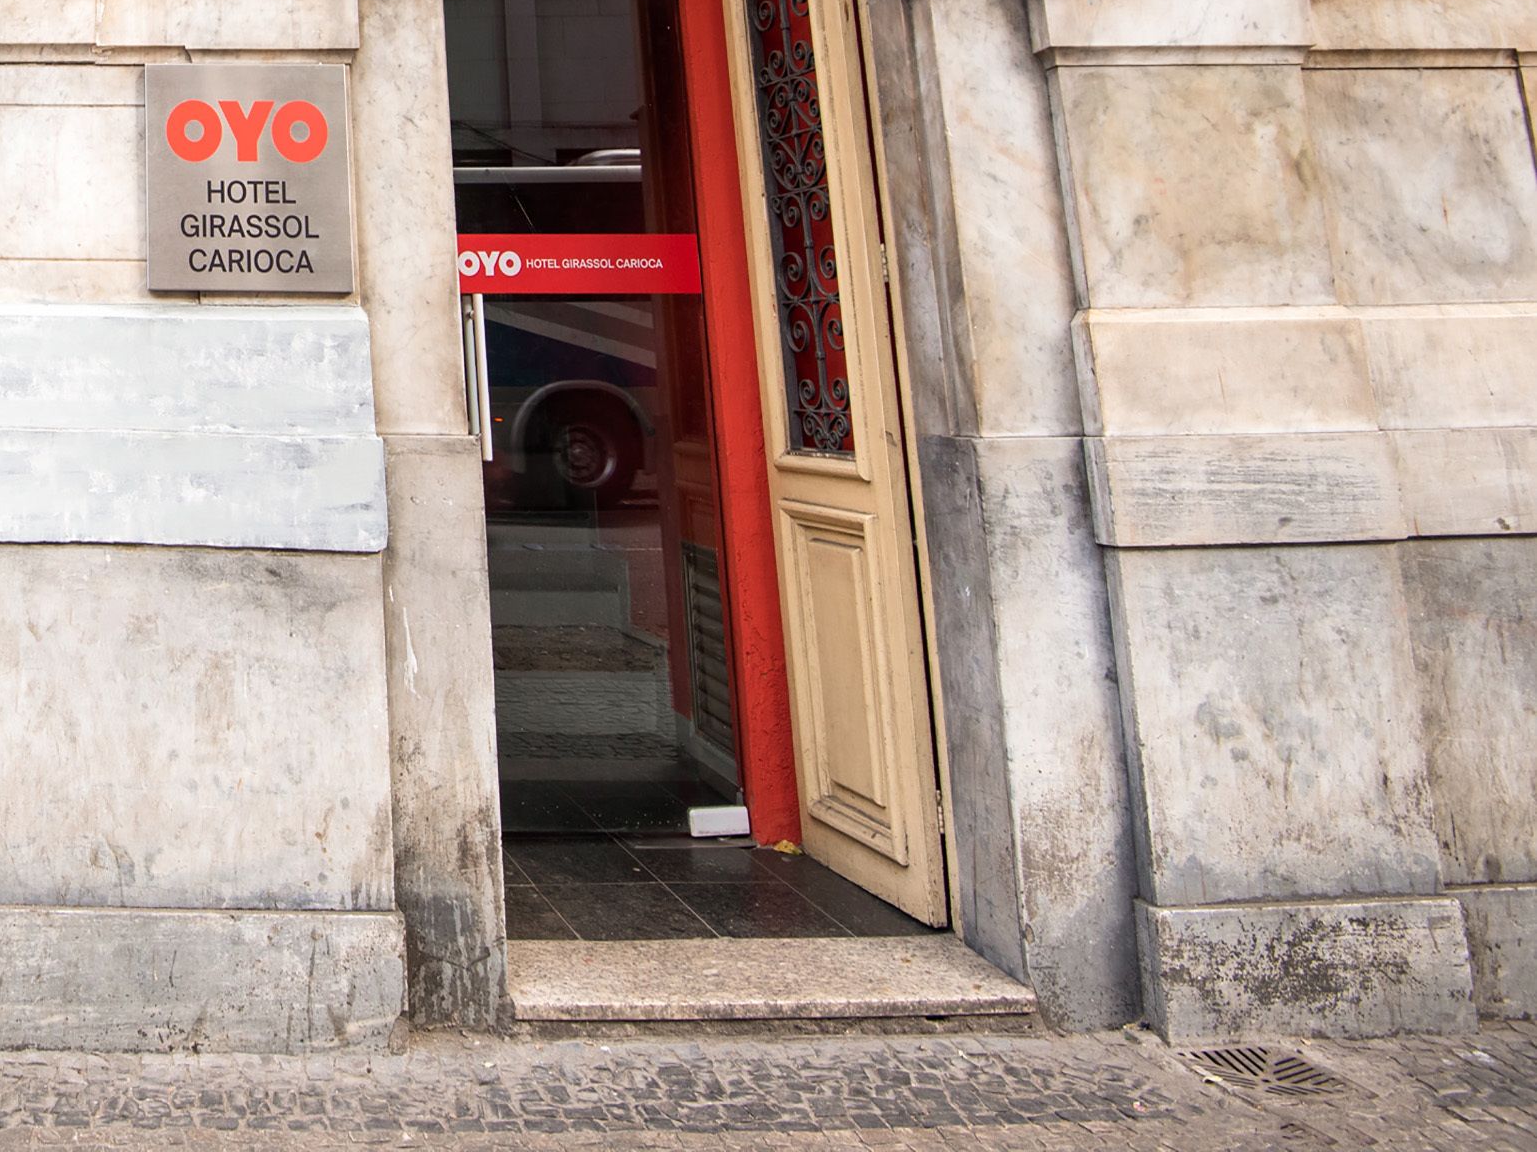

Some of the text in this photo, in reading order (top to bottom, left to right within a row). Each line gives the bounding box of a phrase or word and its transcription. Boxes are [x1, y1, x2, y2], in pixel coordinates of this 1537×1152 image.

[165, 98, 328, 164] OYO
[206, 180, 296, 205] HOTEL
[180, 214, 320, 239] GIRASSOL
[188, 248, 314, 274] CARIOCA
[458, 250, 663, 277] OYO HOTEL GIRASSOL CARIOCA
